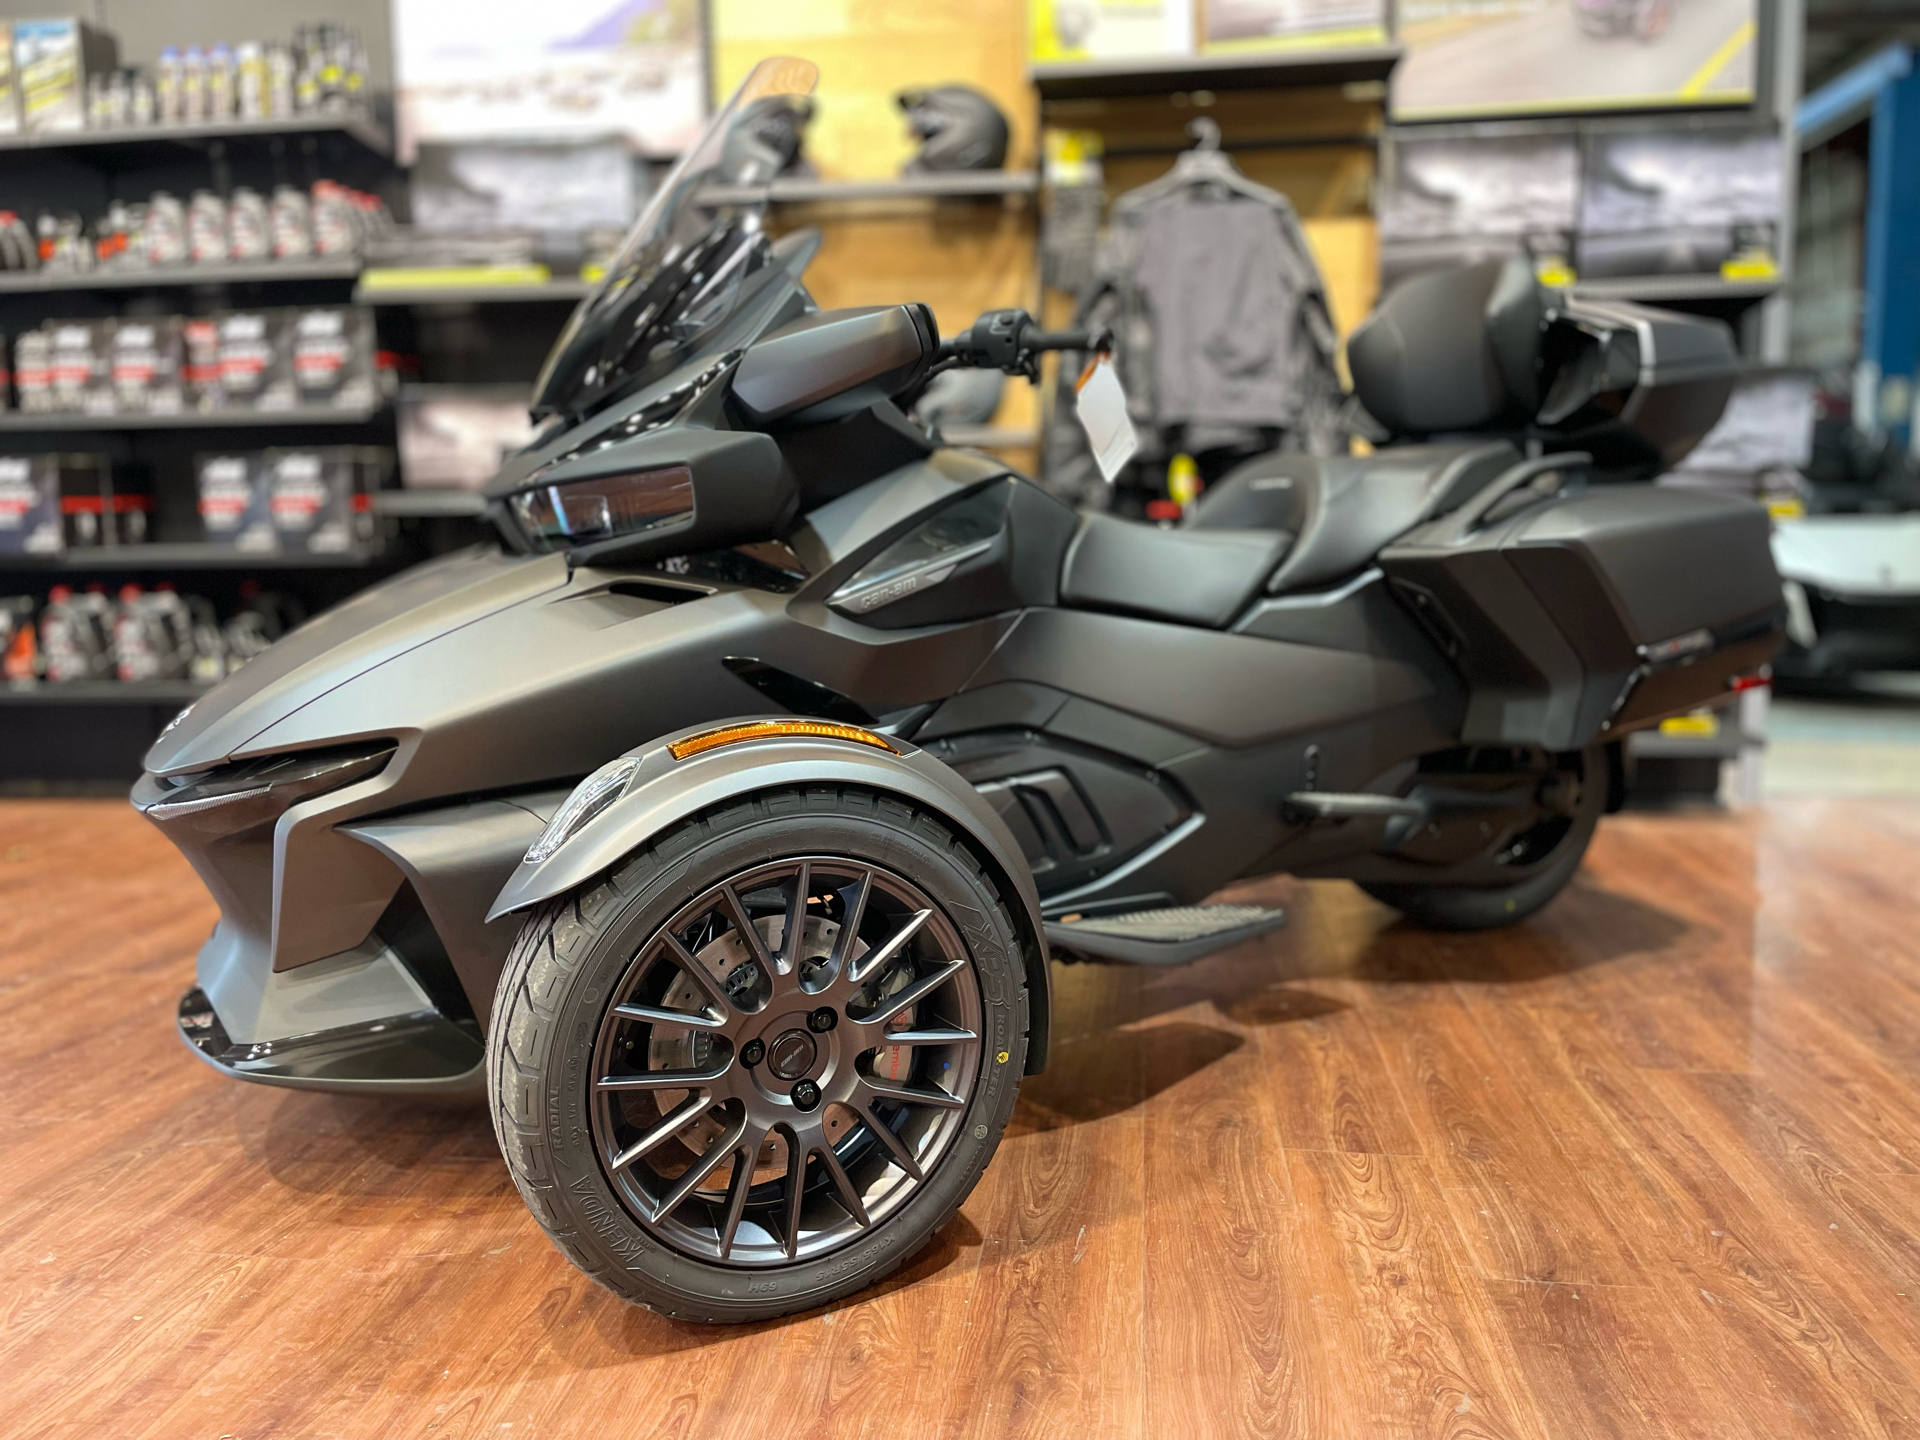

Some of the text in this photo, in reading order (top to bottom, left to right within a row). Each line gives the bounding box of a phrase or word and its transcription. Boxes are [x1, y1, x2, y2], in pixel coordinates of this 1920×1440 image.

[861, 576, 917, 609] can-am
[780, 1044, 804, 1068] can-am
[889, 1044, 901, 1081] embo
[548, 1085, 564, 1150] RADIAL
[569, 1174, 646, 1263] KENDA
[747, 1280, 778, 1294] 69H
